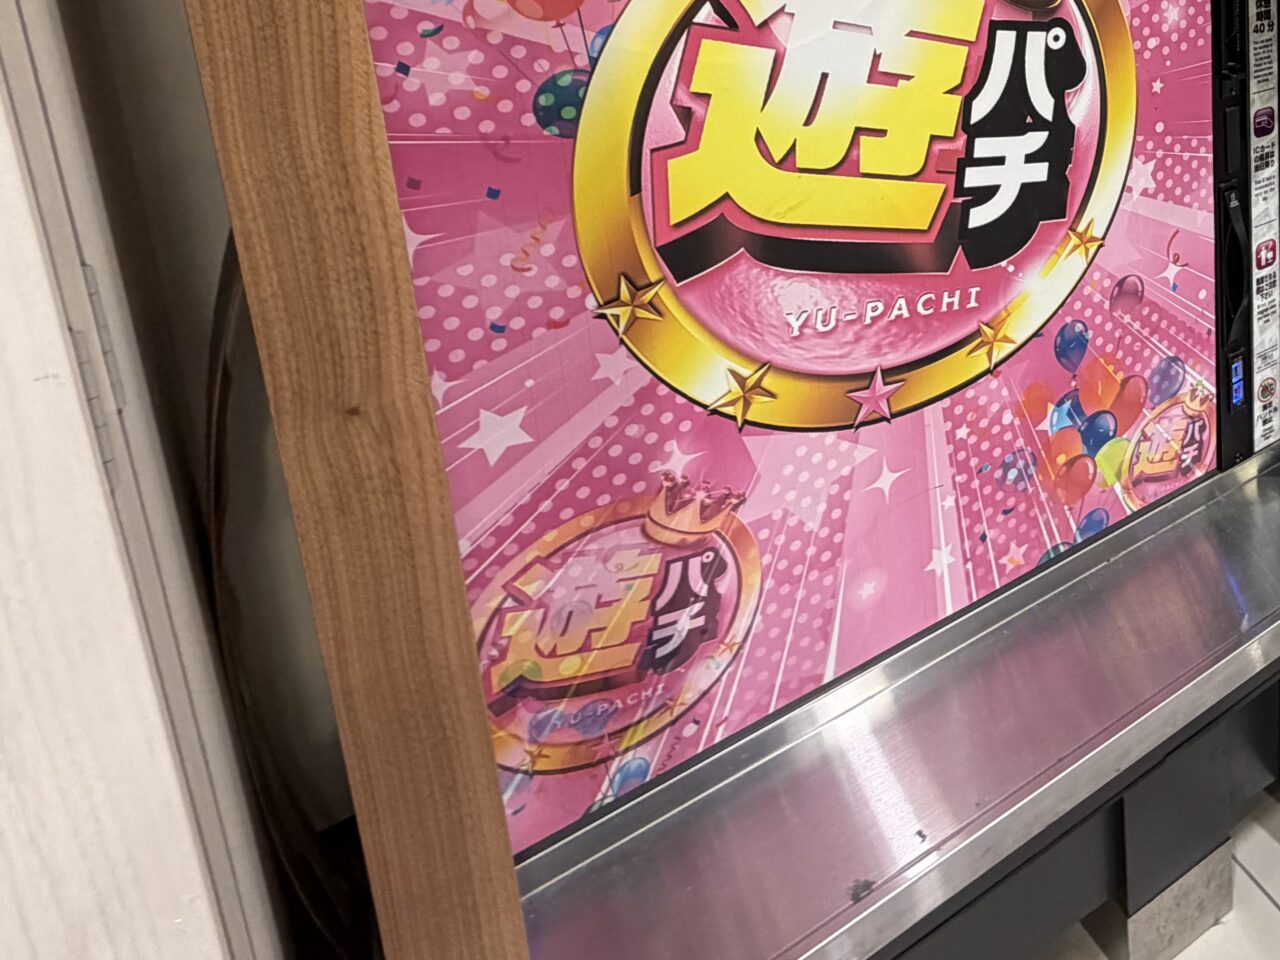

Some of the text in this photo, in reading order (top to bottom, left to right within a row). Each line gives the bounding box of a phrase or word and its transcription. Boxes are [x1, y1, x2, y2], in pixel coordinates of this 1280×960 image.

[963, 26, 1069, 229] パチ
[786, 286, 982, 338] YU-PACHI
[1181, 420, 1204, 469] パチ
[490, 551, 715, 694] 遊 パチ
